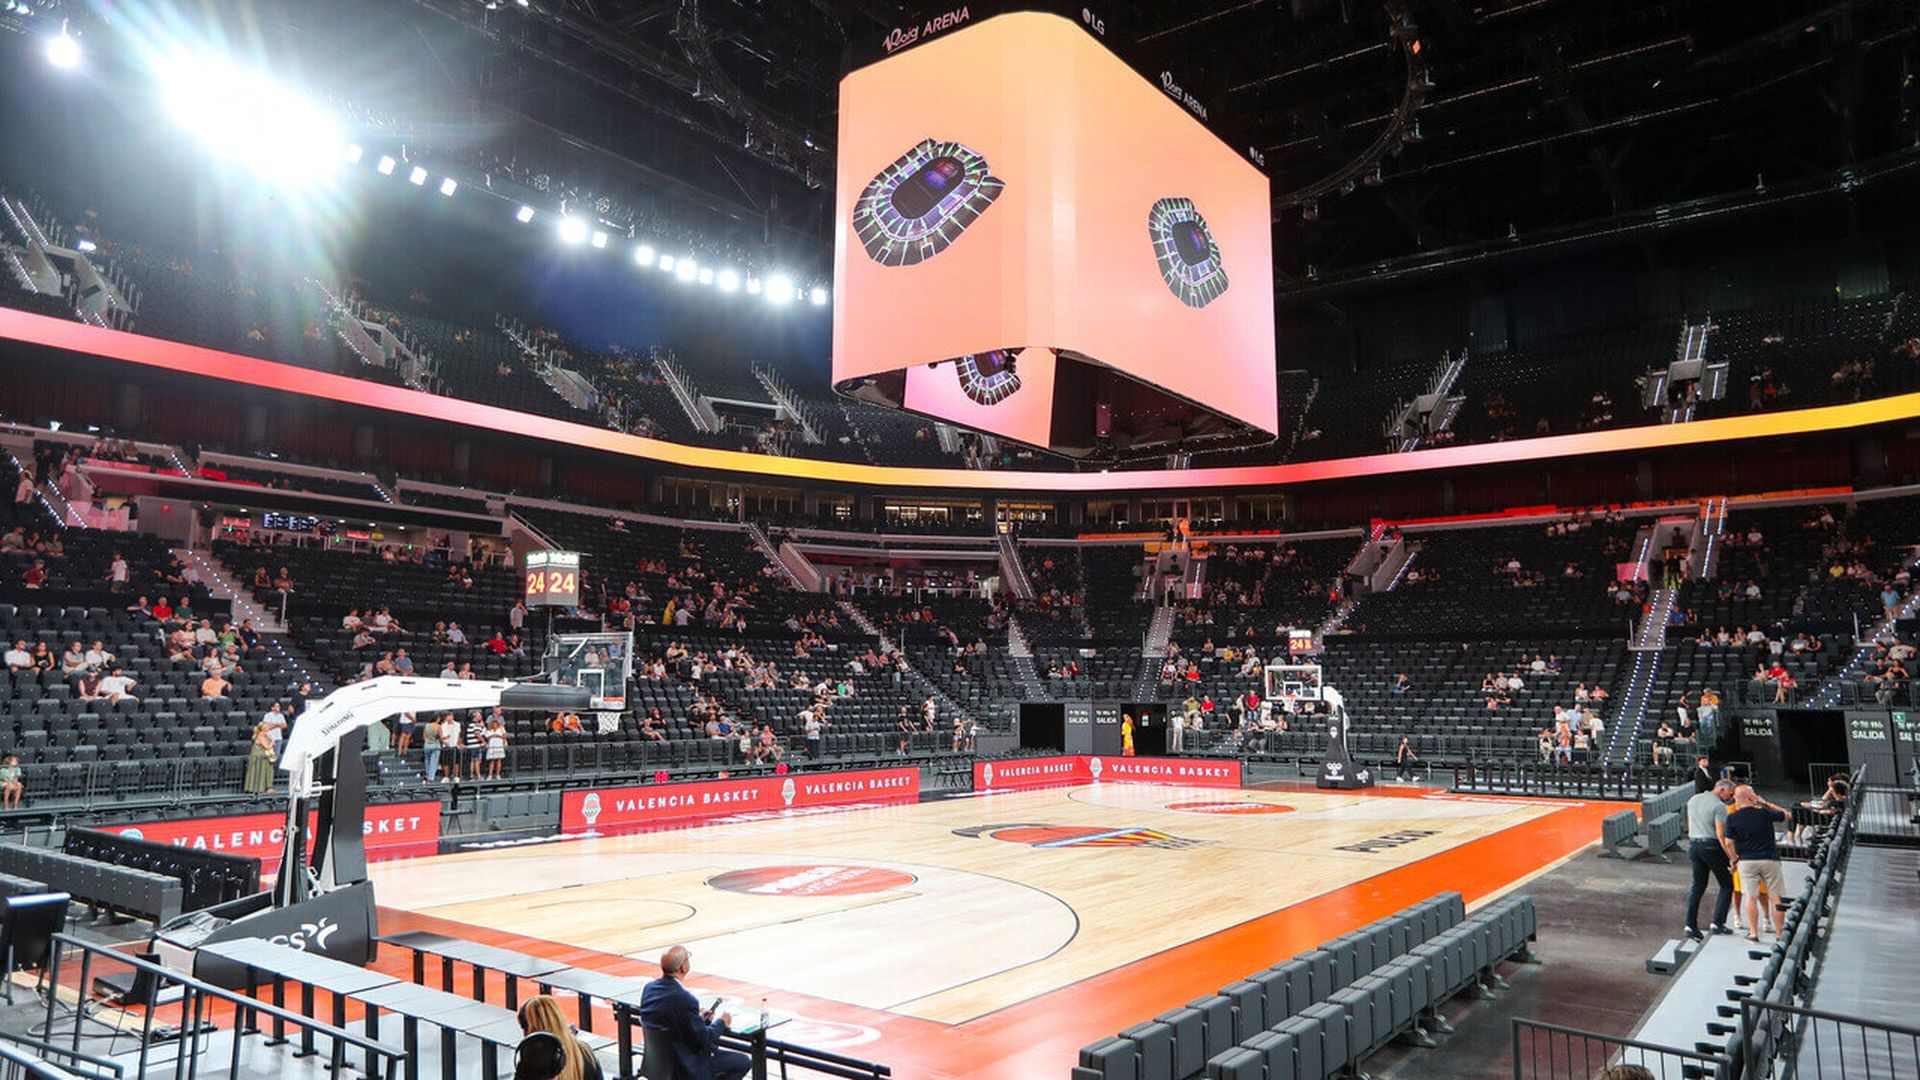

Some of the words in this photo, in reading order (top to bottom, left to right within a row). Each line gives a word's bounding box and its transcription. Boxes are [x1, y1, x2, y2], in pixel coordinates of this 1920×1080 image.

[882, 28, 918, 53] Roig
[923, 6, 970, 37] ARENA
[1092, 20, 1105, 36] LG
[1183, 92, 1208, 120] ARENA
[527, 571, 547, 594] 24
[549, 571, 576, 595] 24
[1743, 727, 1774, 736] SALIDA
[1851, 730, 1886, 740] SALIDA
[1000, 766, 1040, 778] VALENCIA
[1112, 764, 1173, 775] VALENCIA
[1179, 766, 1229, 777] BASKET
[806, 780, 864, 795] VALENCIA
[869, 776, 912, 789] BASKET
[616, 794, 695, 812] VALENCIA
[703, 789, 759, 804] BASKET
[363, 816, 421, 835] SKET
